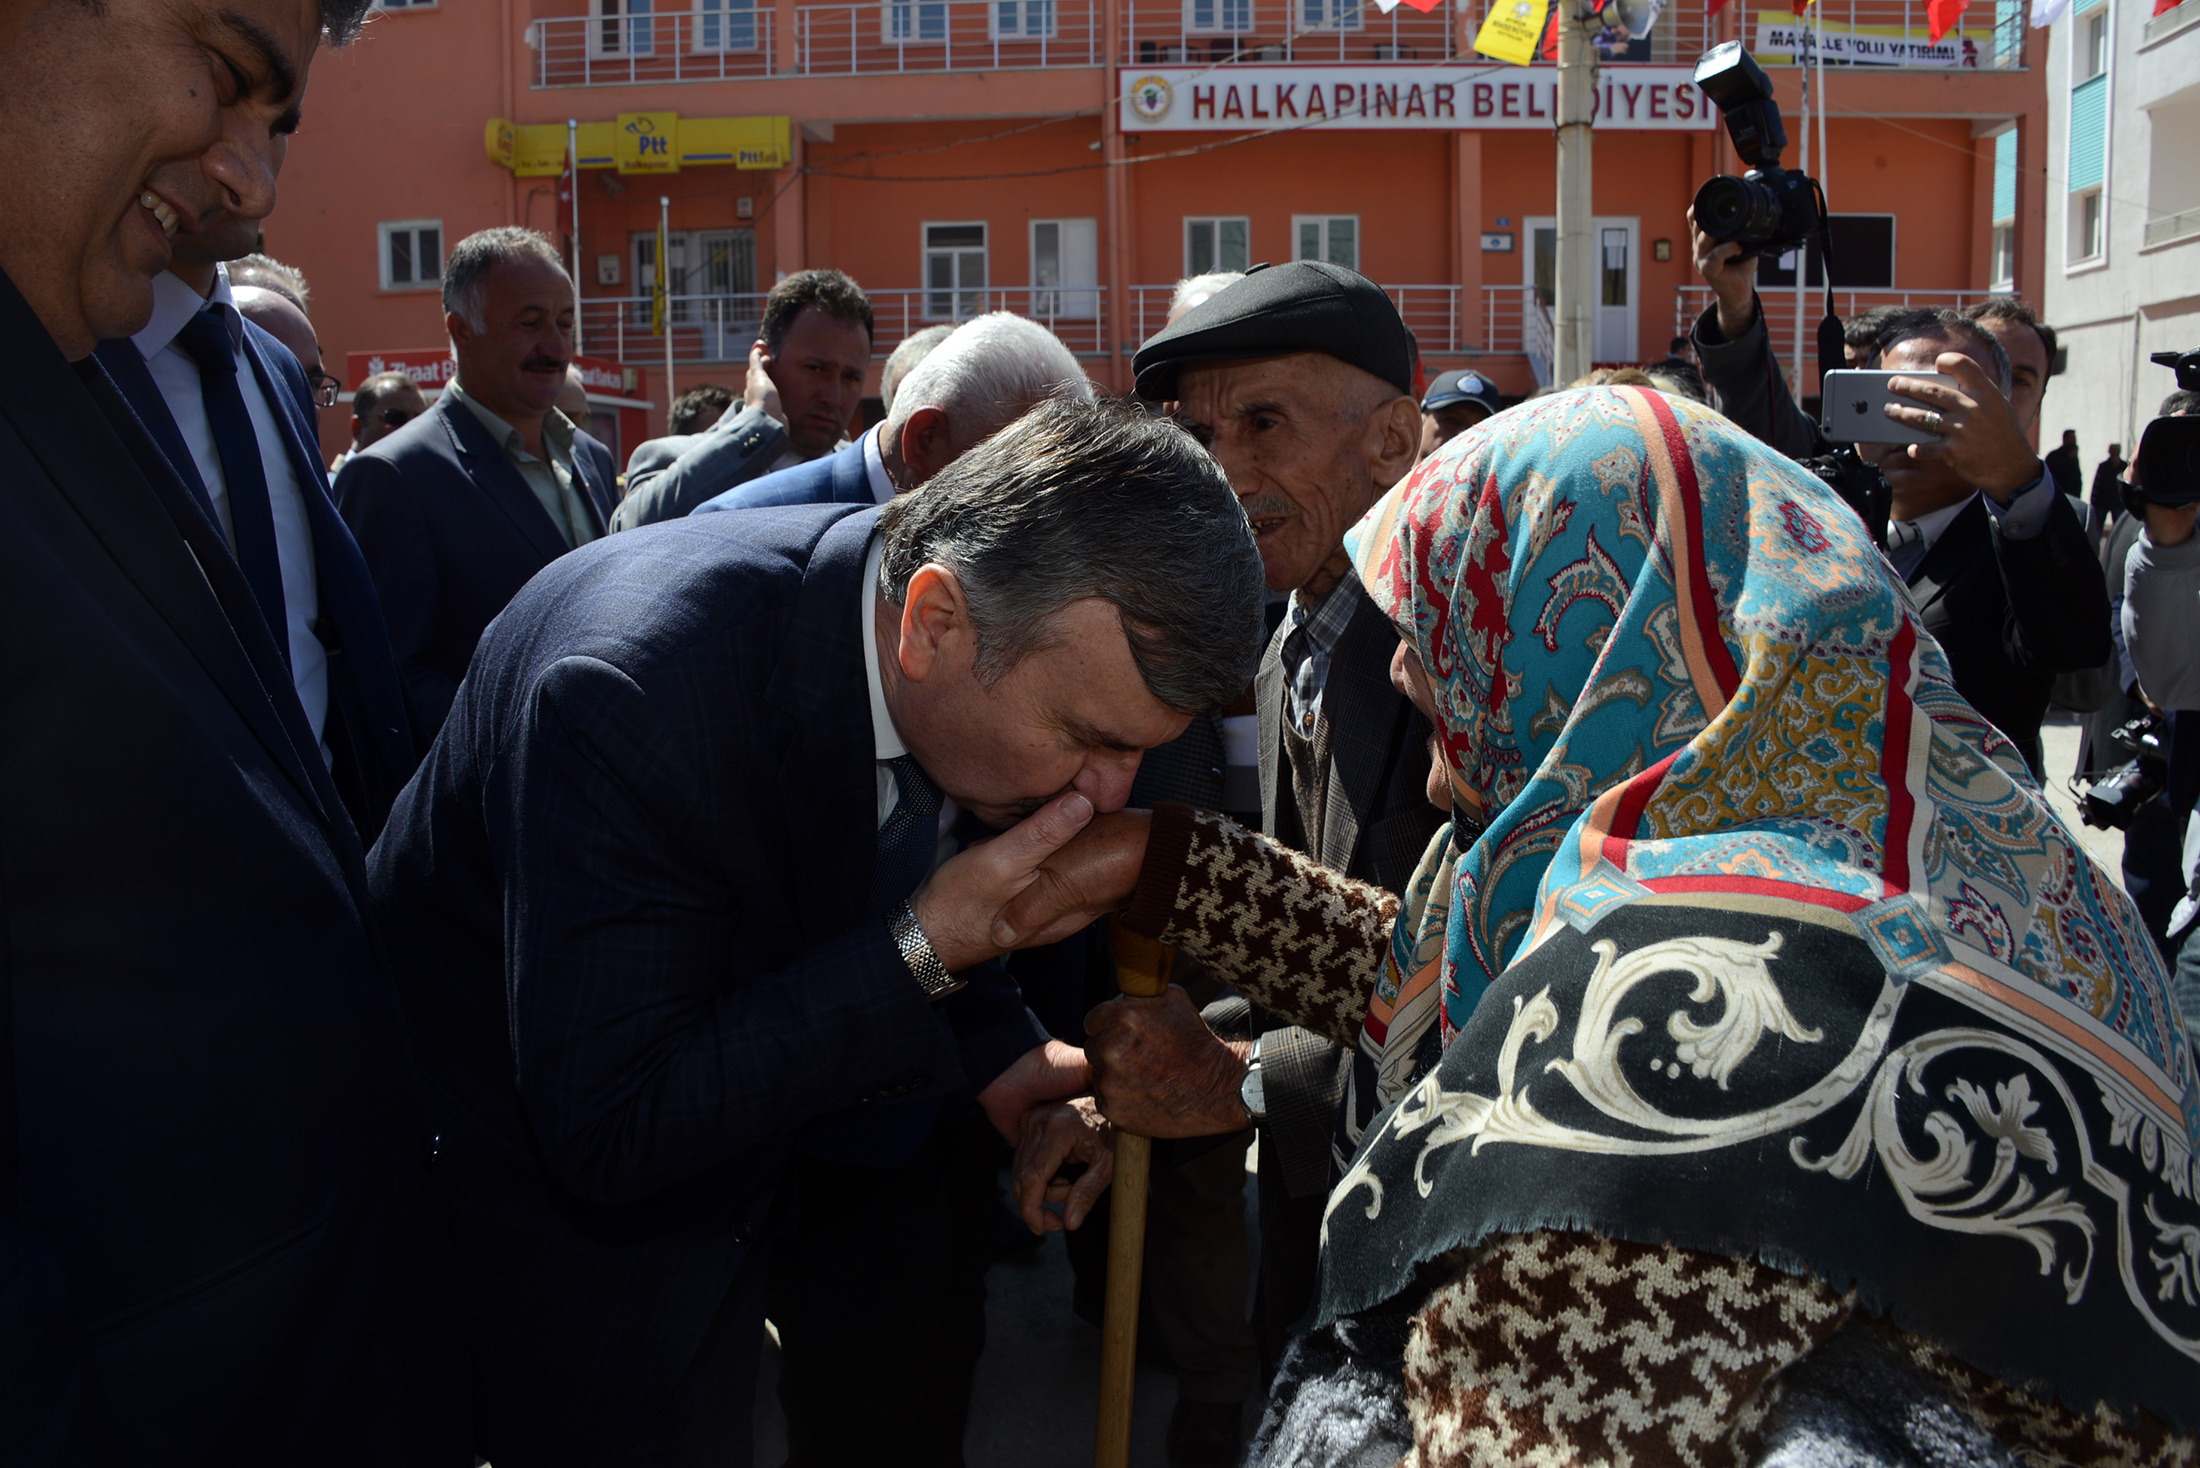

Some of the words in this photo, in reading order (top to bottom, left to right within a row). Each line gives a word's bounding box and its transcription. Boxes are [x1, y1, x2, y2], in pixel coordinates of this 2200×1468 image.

[1769, 30, 1843, 51] MAHALE
[1192, 83, 1455, 120] HALKAPINAR
[639, 135, 668, 156] Ptt
